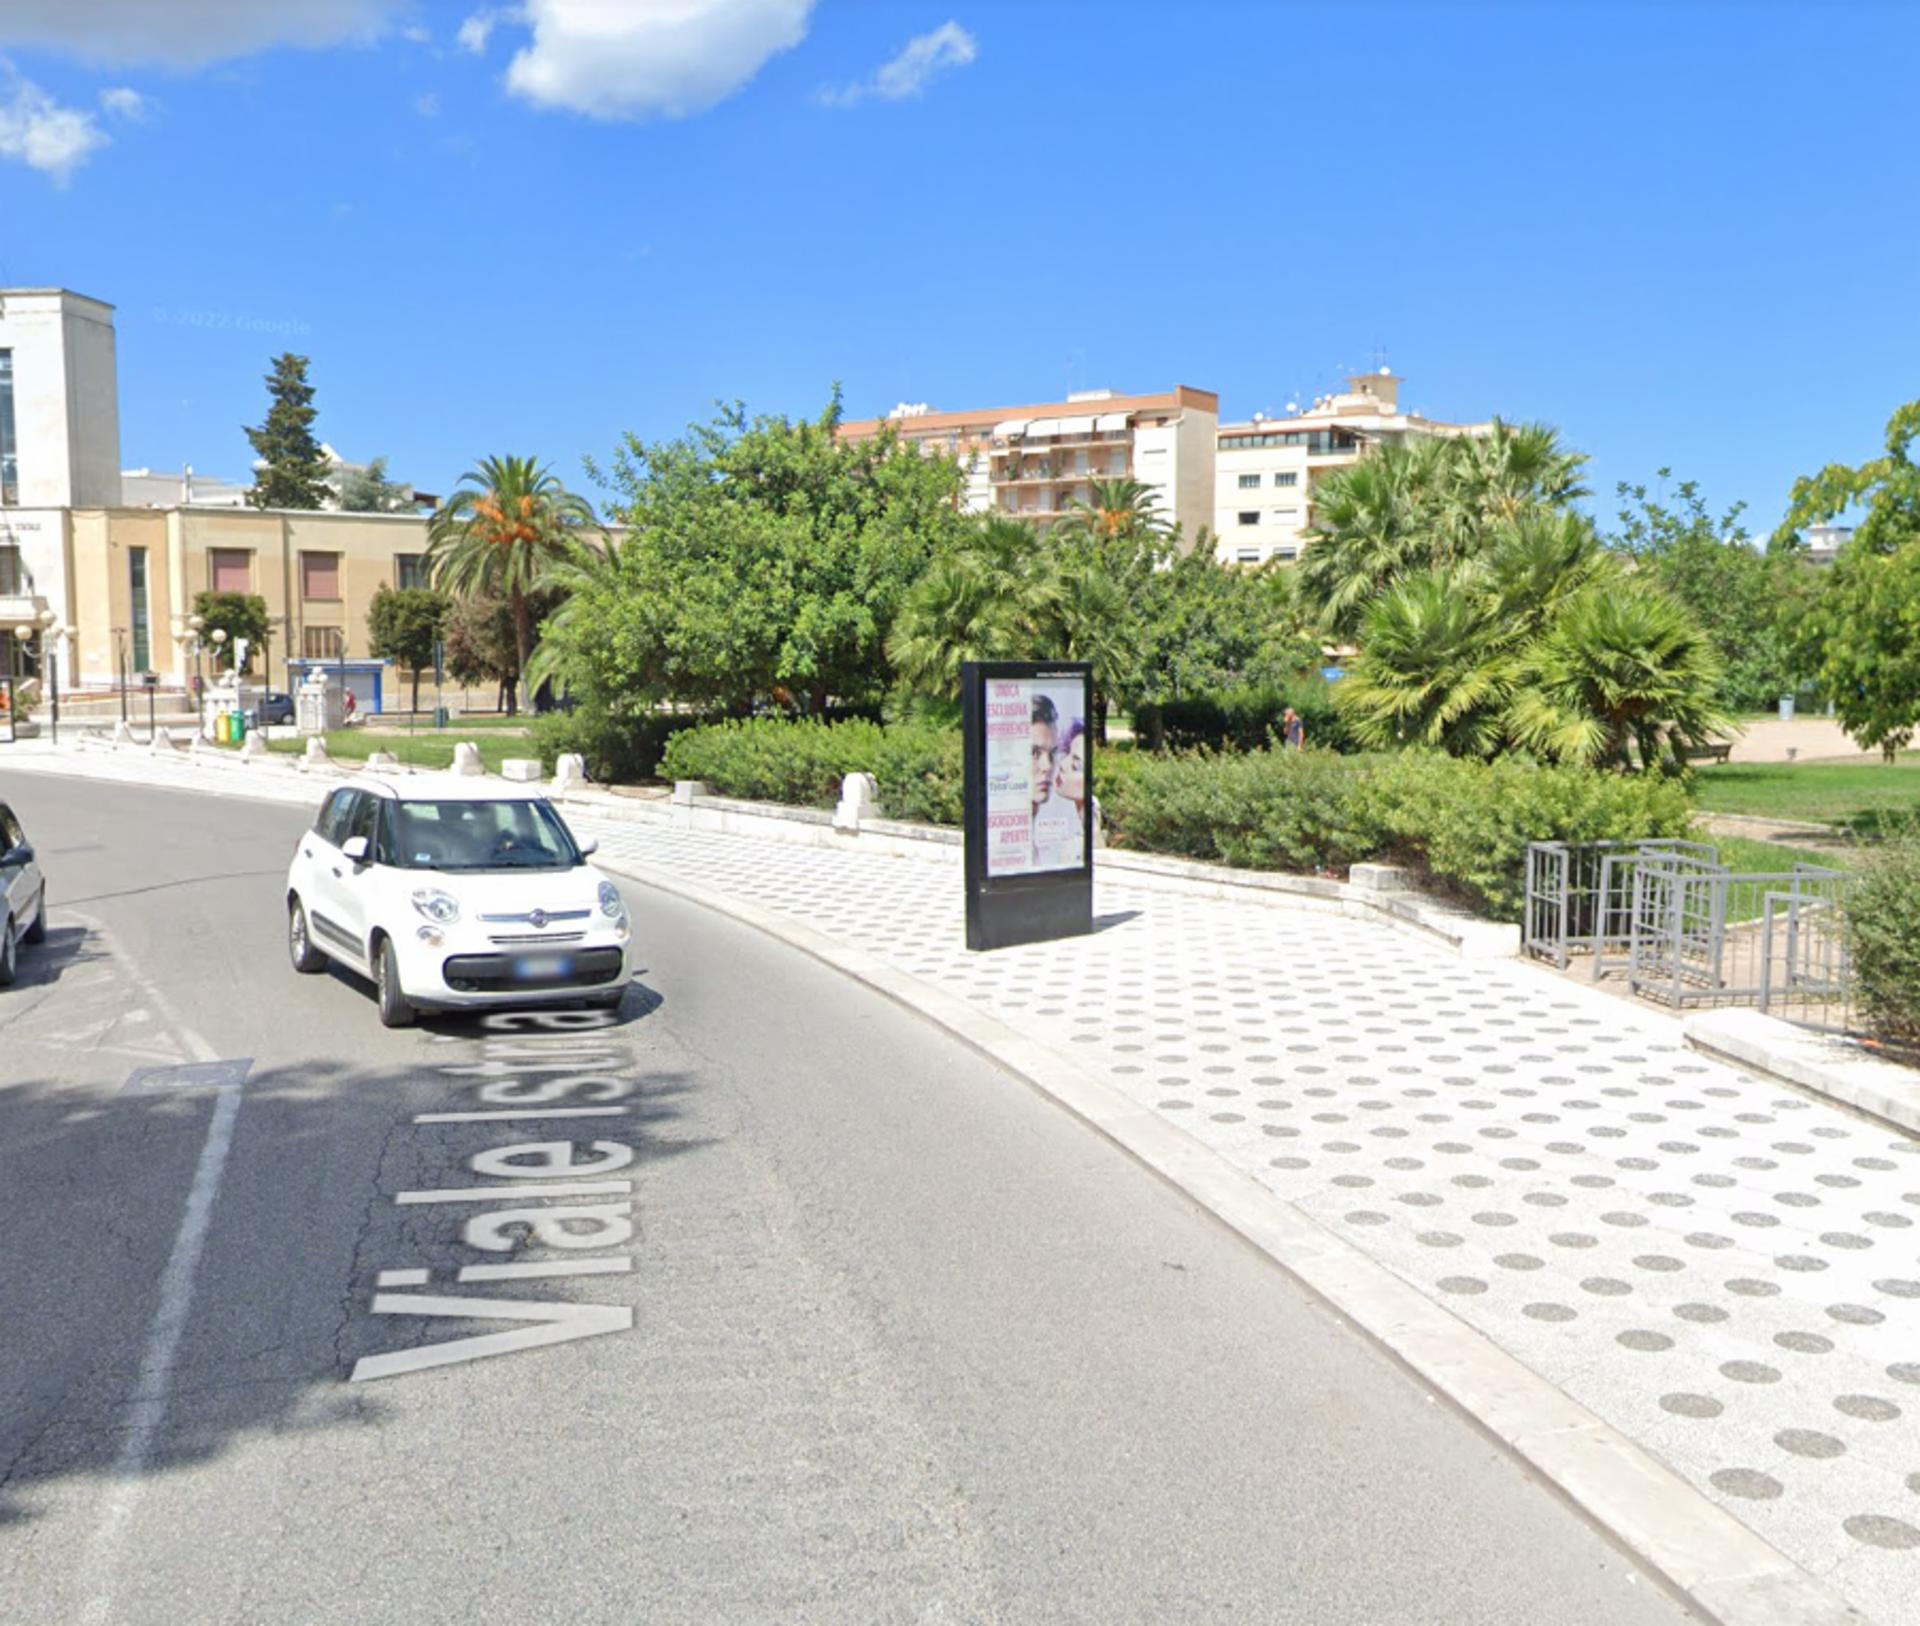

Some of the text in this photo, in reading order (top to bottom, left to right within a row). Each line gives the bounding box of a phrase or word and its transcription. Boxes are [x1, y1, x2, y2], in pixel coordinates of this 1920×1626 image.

[994, 683, 1020, 697] UNICA
[986, 703, 1028, 717] ESCLUSIVA
[1000, 830, 1029, 843] APERTE
